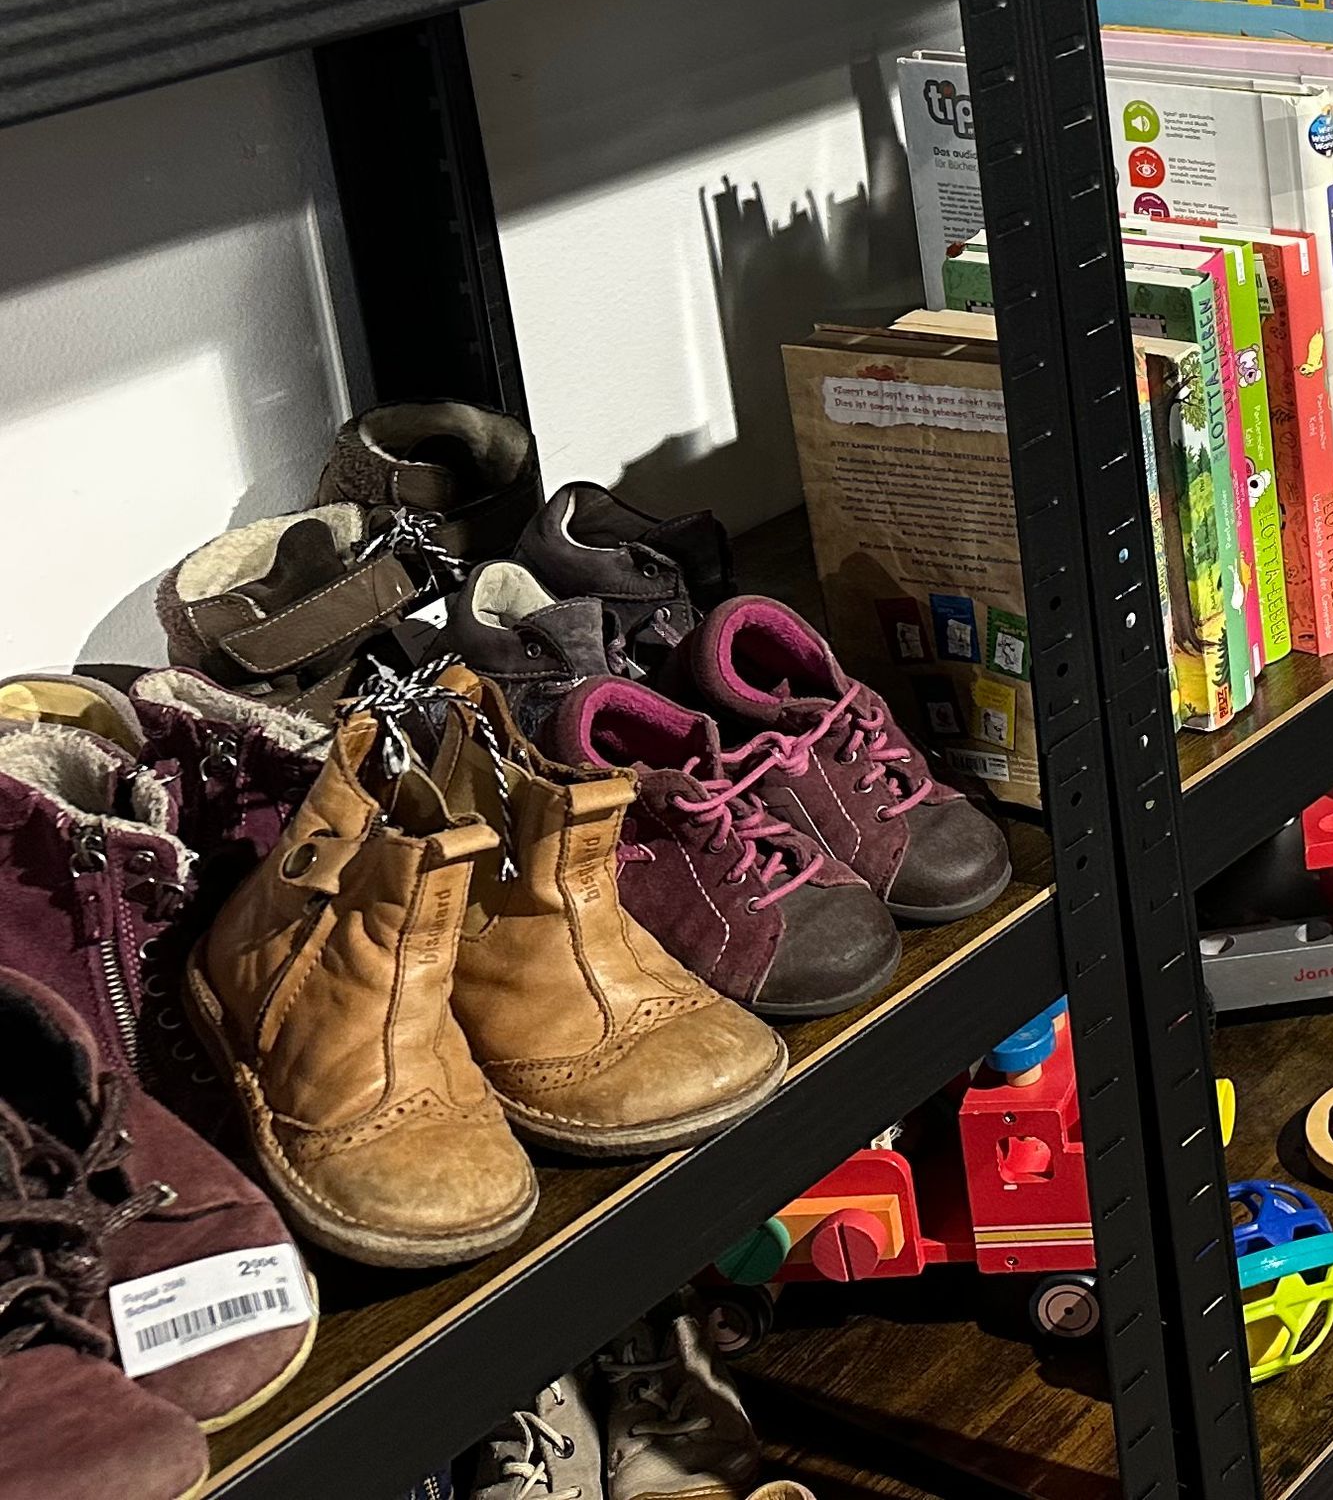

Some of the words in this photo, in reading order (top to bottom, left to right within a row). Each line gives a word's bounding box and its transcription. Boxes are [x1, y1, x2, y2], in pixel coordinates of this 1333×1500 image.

[933, 146, 951, 156] Das
[1199, 296, 1227, 453] LOTTA-LEBEN
[1309, 415, 1318, 436] Kohl
[1244, 427, 1254, 448] Kohl
[1260, 512, 1287, 645] LOTTA-LEBEN
